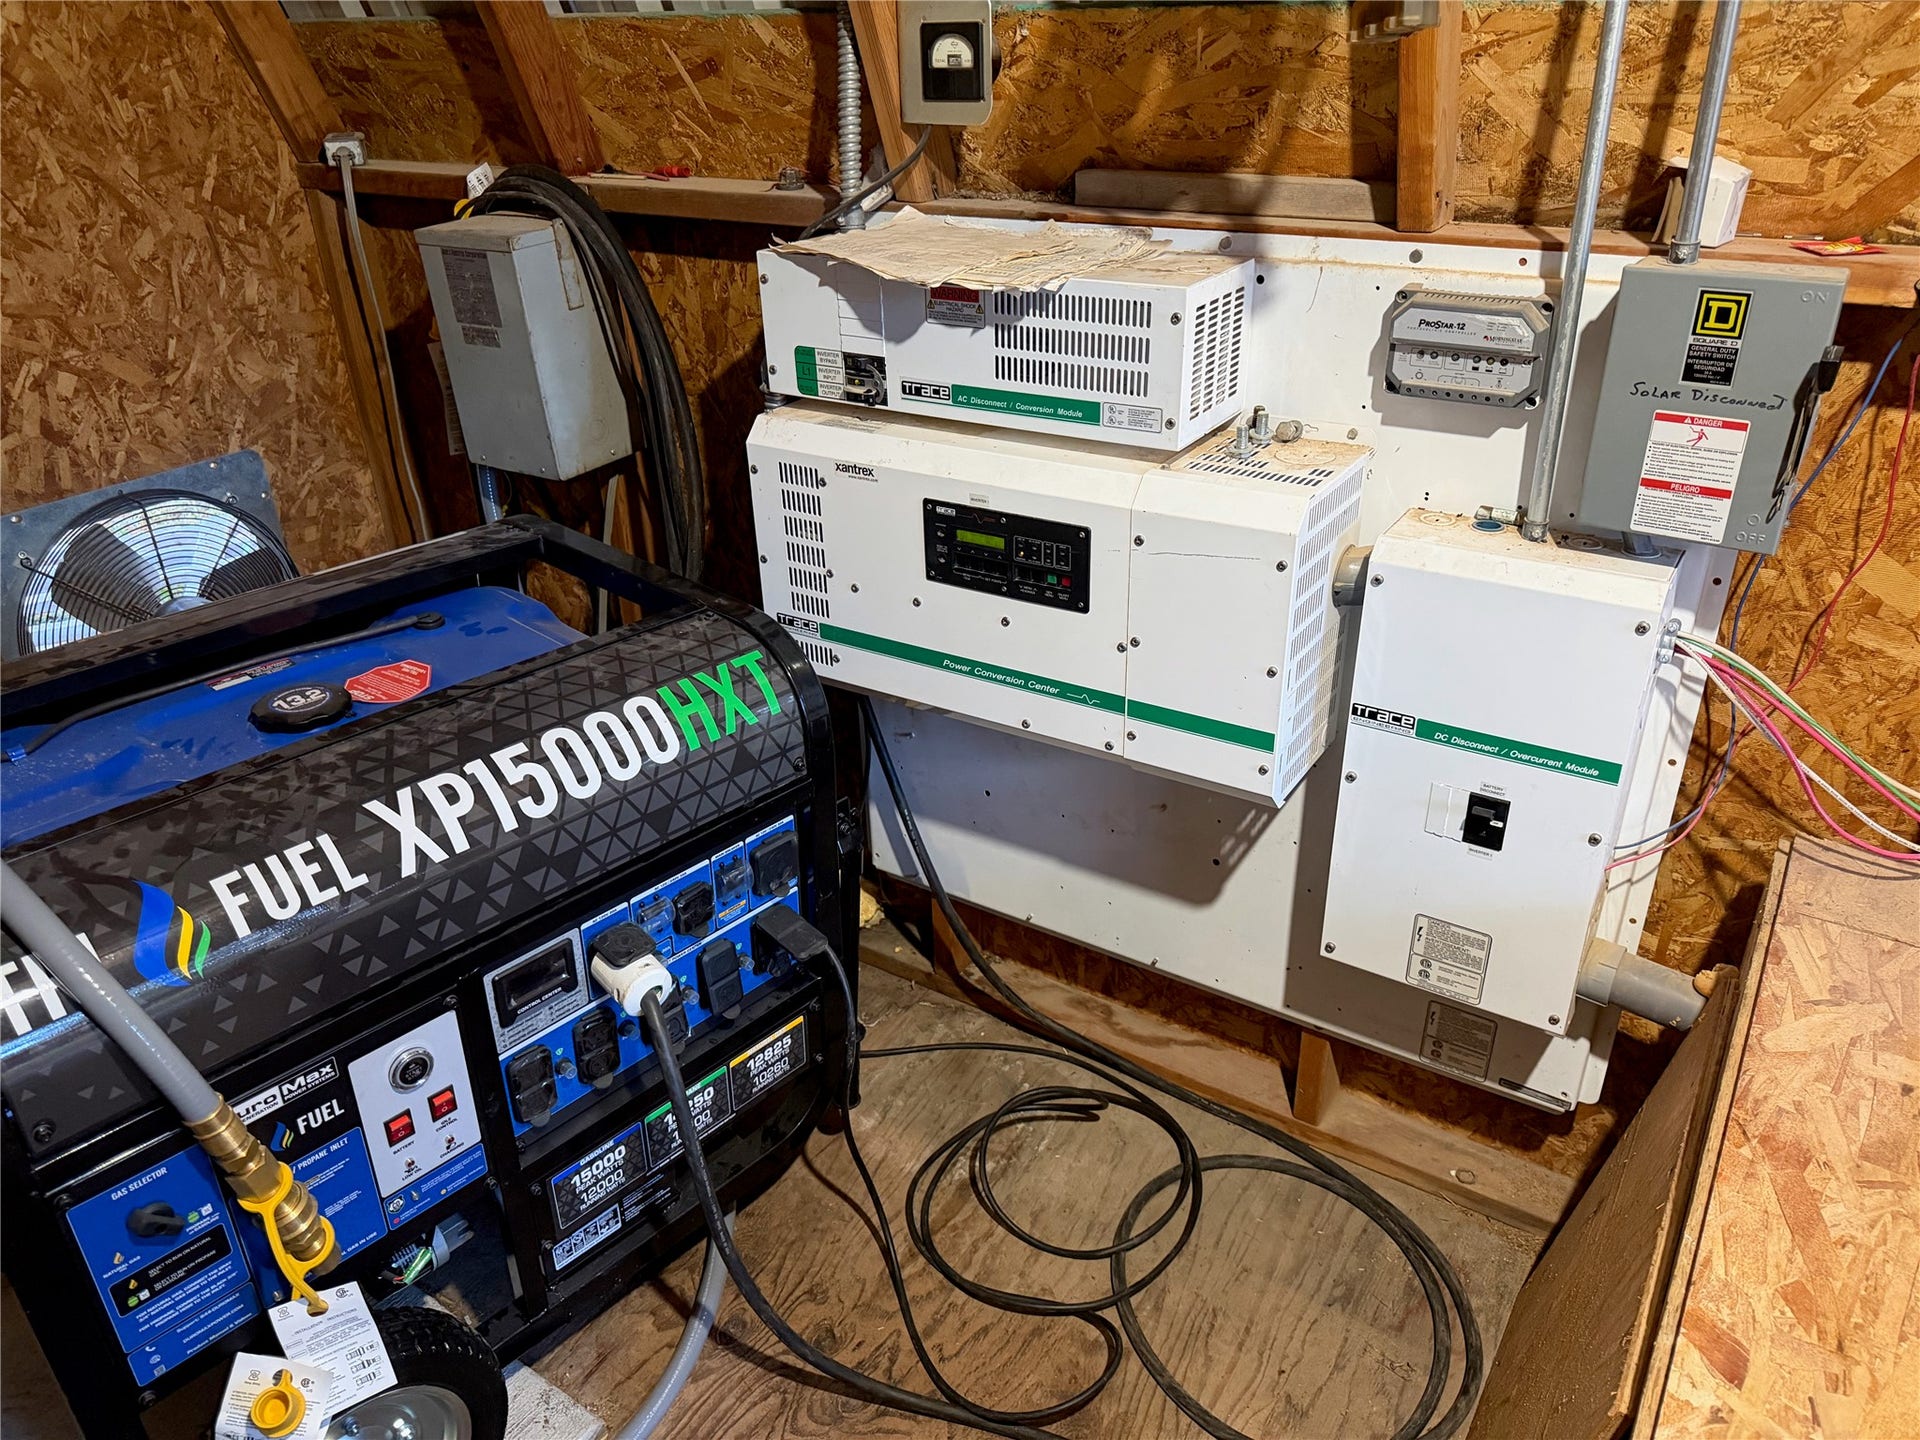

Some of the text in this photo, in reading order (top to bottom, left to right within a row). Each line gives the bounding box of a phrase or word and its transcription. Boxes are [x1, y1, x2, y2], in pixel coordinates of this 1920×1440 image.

[932, 287, 978, 301] WARNING
[1801, 290, 1829, 303] ON
[1693, 337, 1727, 345] SQUARE
[817, 351, 840, 359] INVERTER
[820, 357, 838, 365] BYPASS
[1687, 358, 1725, 367] INTERRUPTOR
[818, 367, 841, 376] INVERTER
[820, 383, 843, 392] INVERTER
[821, 389, 840, 397] OUTPUT
[957, 395, 967, 403] AC
[970, 396, 1007, 409] Disconnect
[1015, 403, 1054, 415] Conversion
[1057, 408, 1083, 418] Module
[1693, 418, 1723, 427] DANGER
[835, 463, 875, 477] xantrex
[1670, 483, 1701, 493] PELIGRO
[1736, 531, 1766, 544] OFF
[943, 659, 1060, 695] Power Conversion Center
[272, 688, 327, 709] 13.2
[1434, 732, 1449, 741] DC
[1451, 736, 1499, 753] Disconnect
[1510, 750, 1562, 768] Overcurrent
[1565, 762, 1599, 776] Module
[209, 649, 783, 940] FUEL XP15000HXT
[1480, 787, 1505, 797] DISCONNECT
[1483, 783, 1504, 791] BATTERY
[517, 986, 562, 1015] CONTROL CENTER
[746, 1034, 792, 1070] 12825
[750, 1048, 790, 1078] PEAK WATTS
[753, 1057, 789, 1086] 10260
[284, 1071, 336, 1101] POWER SYSTEMS
[752, 1064, 790, 1094] RUNNING WATTS
[296, 1098, 345, 1135] FUEL
[435, 1118, 458, 1132] CONTROL
[296, 1148, 329, 1170] PROPANE
[328, 1137, 349, 1151] INLET
[393, 1140, 415, 1154] BATTERY
[439, 1142, 464, 1159] CHARGING
[580, 1139, 615, 1165] GASOLINE
[401, 1166, 422, 1181] LOW OIL
[571, 1145, 626, 1187] 15000
[575, 1158, 624, 1194] PEAK WATTS
[111, 1167, 168, 1200] GAS SELECTOR
[580, 1168, 623, 1201] 12000
[580, 1177, 626, 1211] RUNNING WATTS
[103, 1255, 141, 1279] NATURAL GAS
